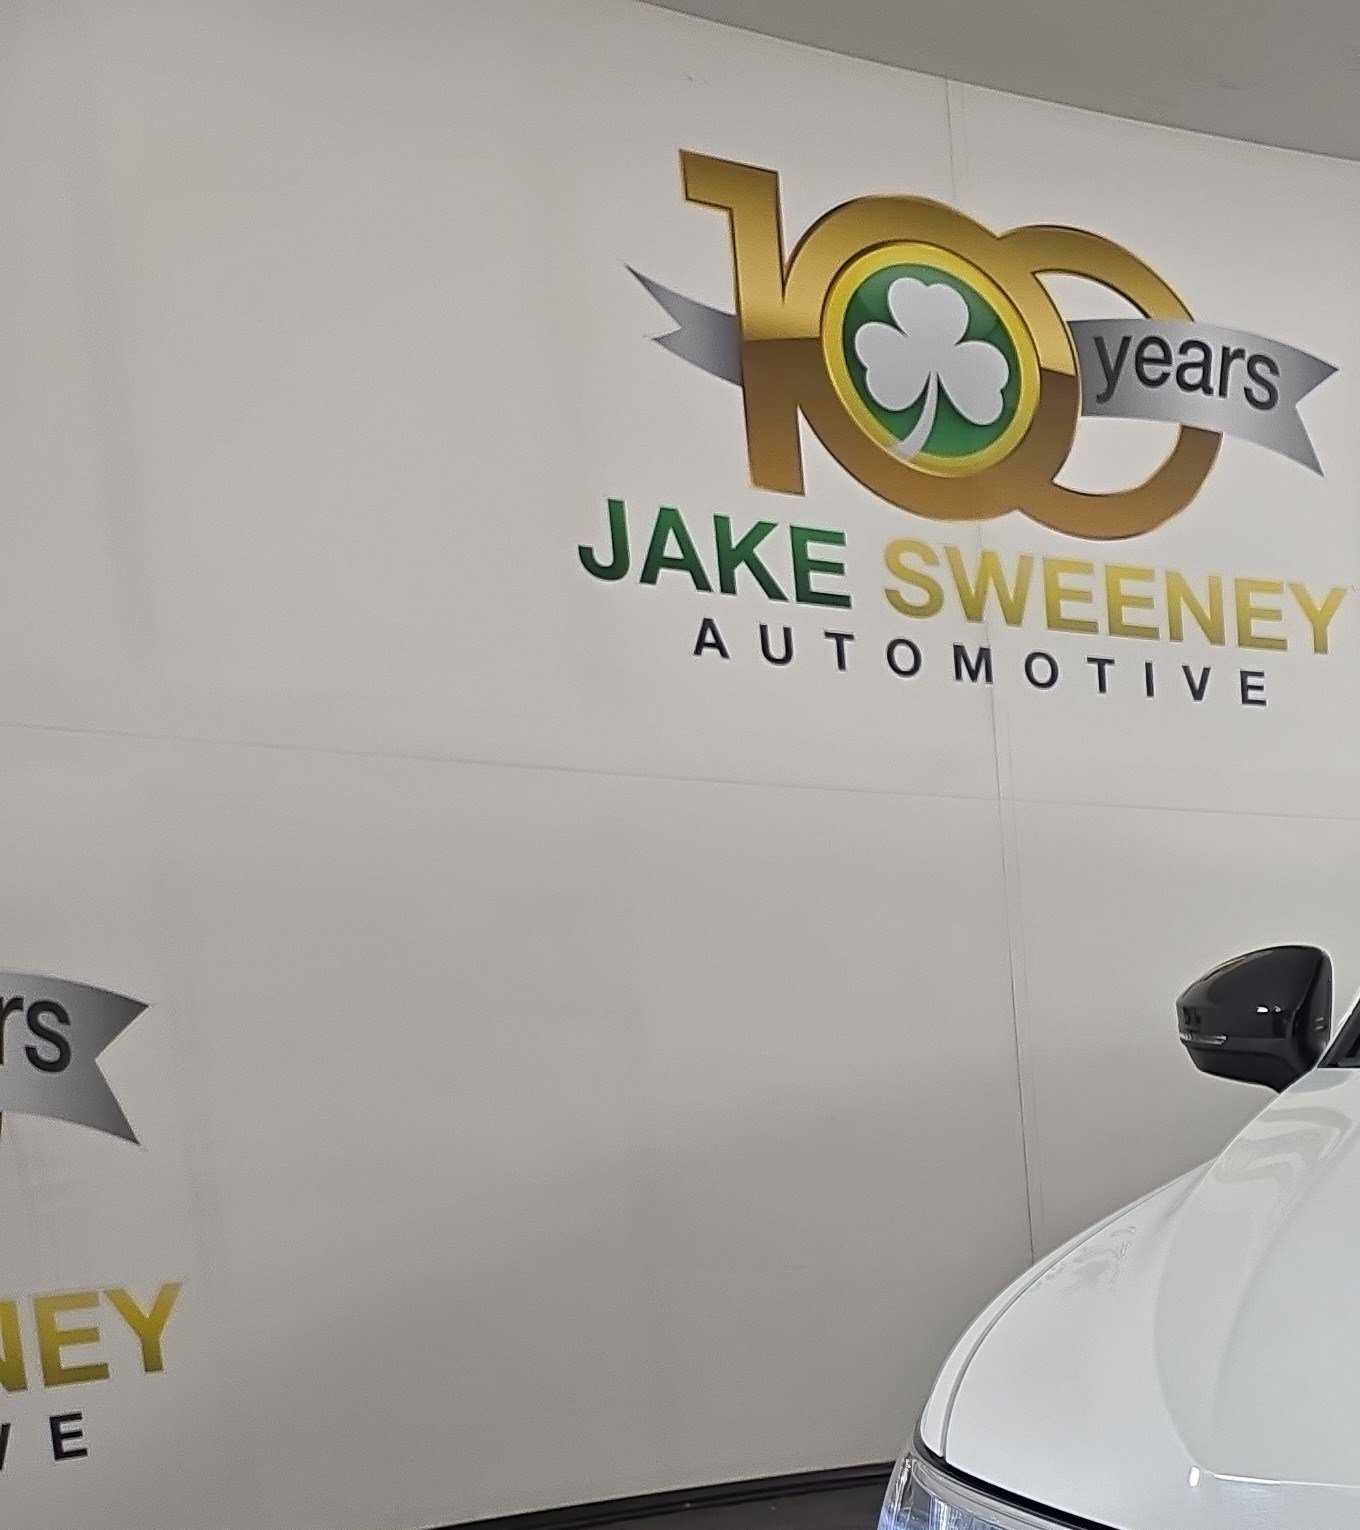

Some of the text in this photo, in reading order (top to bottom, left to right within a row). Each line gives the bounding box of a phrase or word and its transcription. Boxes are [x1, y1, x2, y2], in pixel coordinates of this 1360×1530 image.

[1093, 330, 1281, 412] years
[578, 499, 1350, 656] JAKE SWEENEY
[693, 618, 1269, 708] AUTOMOTIVE
